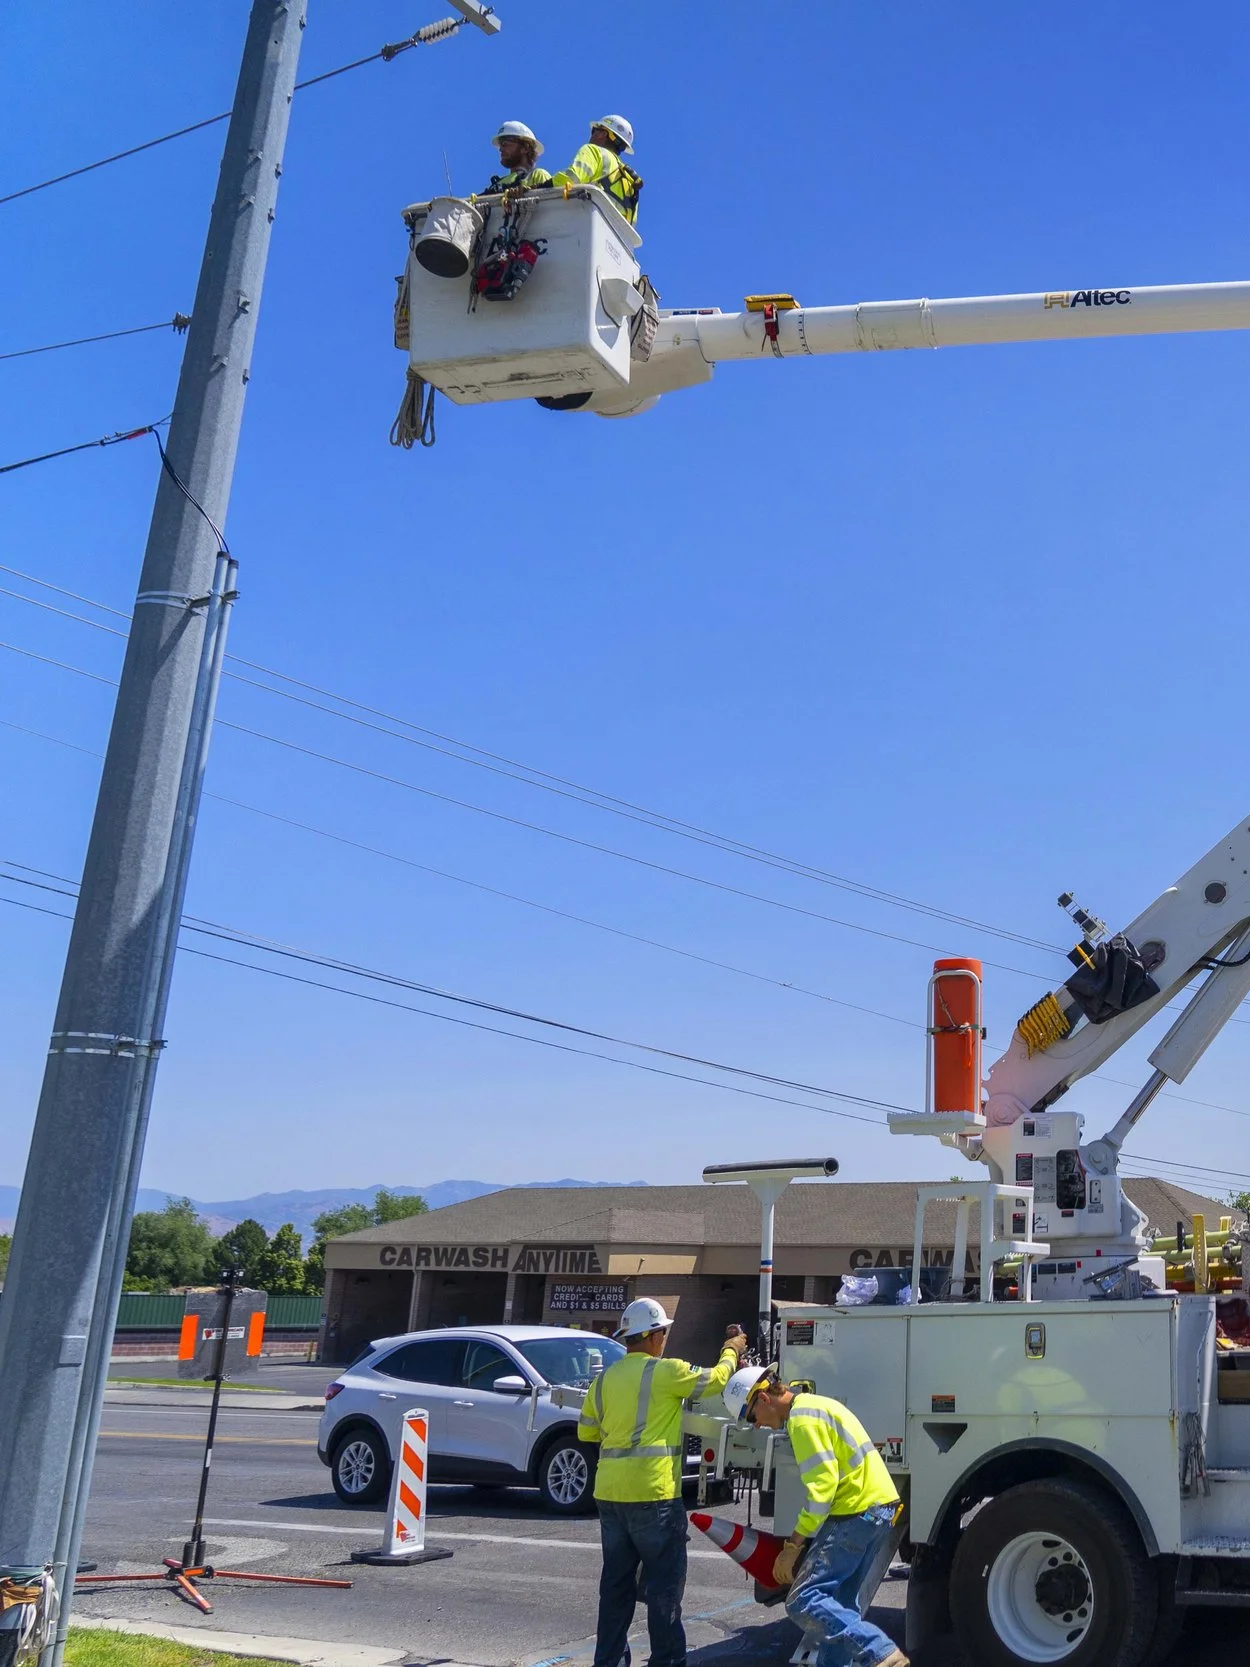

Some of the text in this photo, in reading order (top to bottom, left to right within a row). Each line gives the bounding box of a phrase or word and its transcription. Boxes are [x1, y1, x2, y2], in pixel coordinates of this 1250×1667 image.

[1070, 290, 1130, 307] Altec
[380, 1246, 510, 1268] CARWASH
[511, 1245, 602, 1273] ANYTIME
[555, 1285, 624, 1293] NOW ACCEPTING
[595, 1293, 624, 1301] CARDS
[550, 1301, 627, 1310] AND $1 & $5 BILLS
